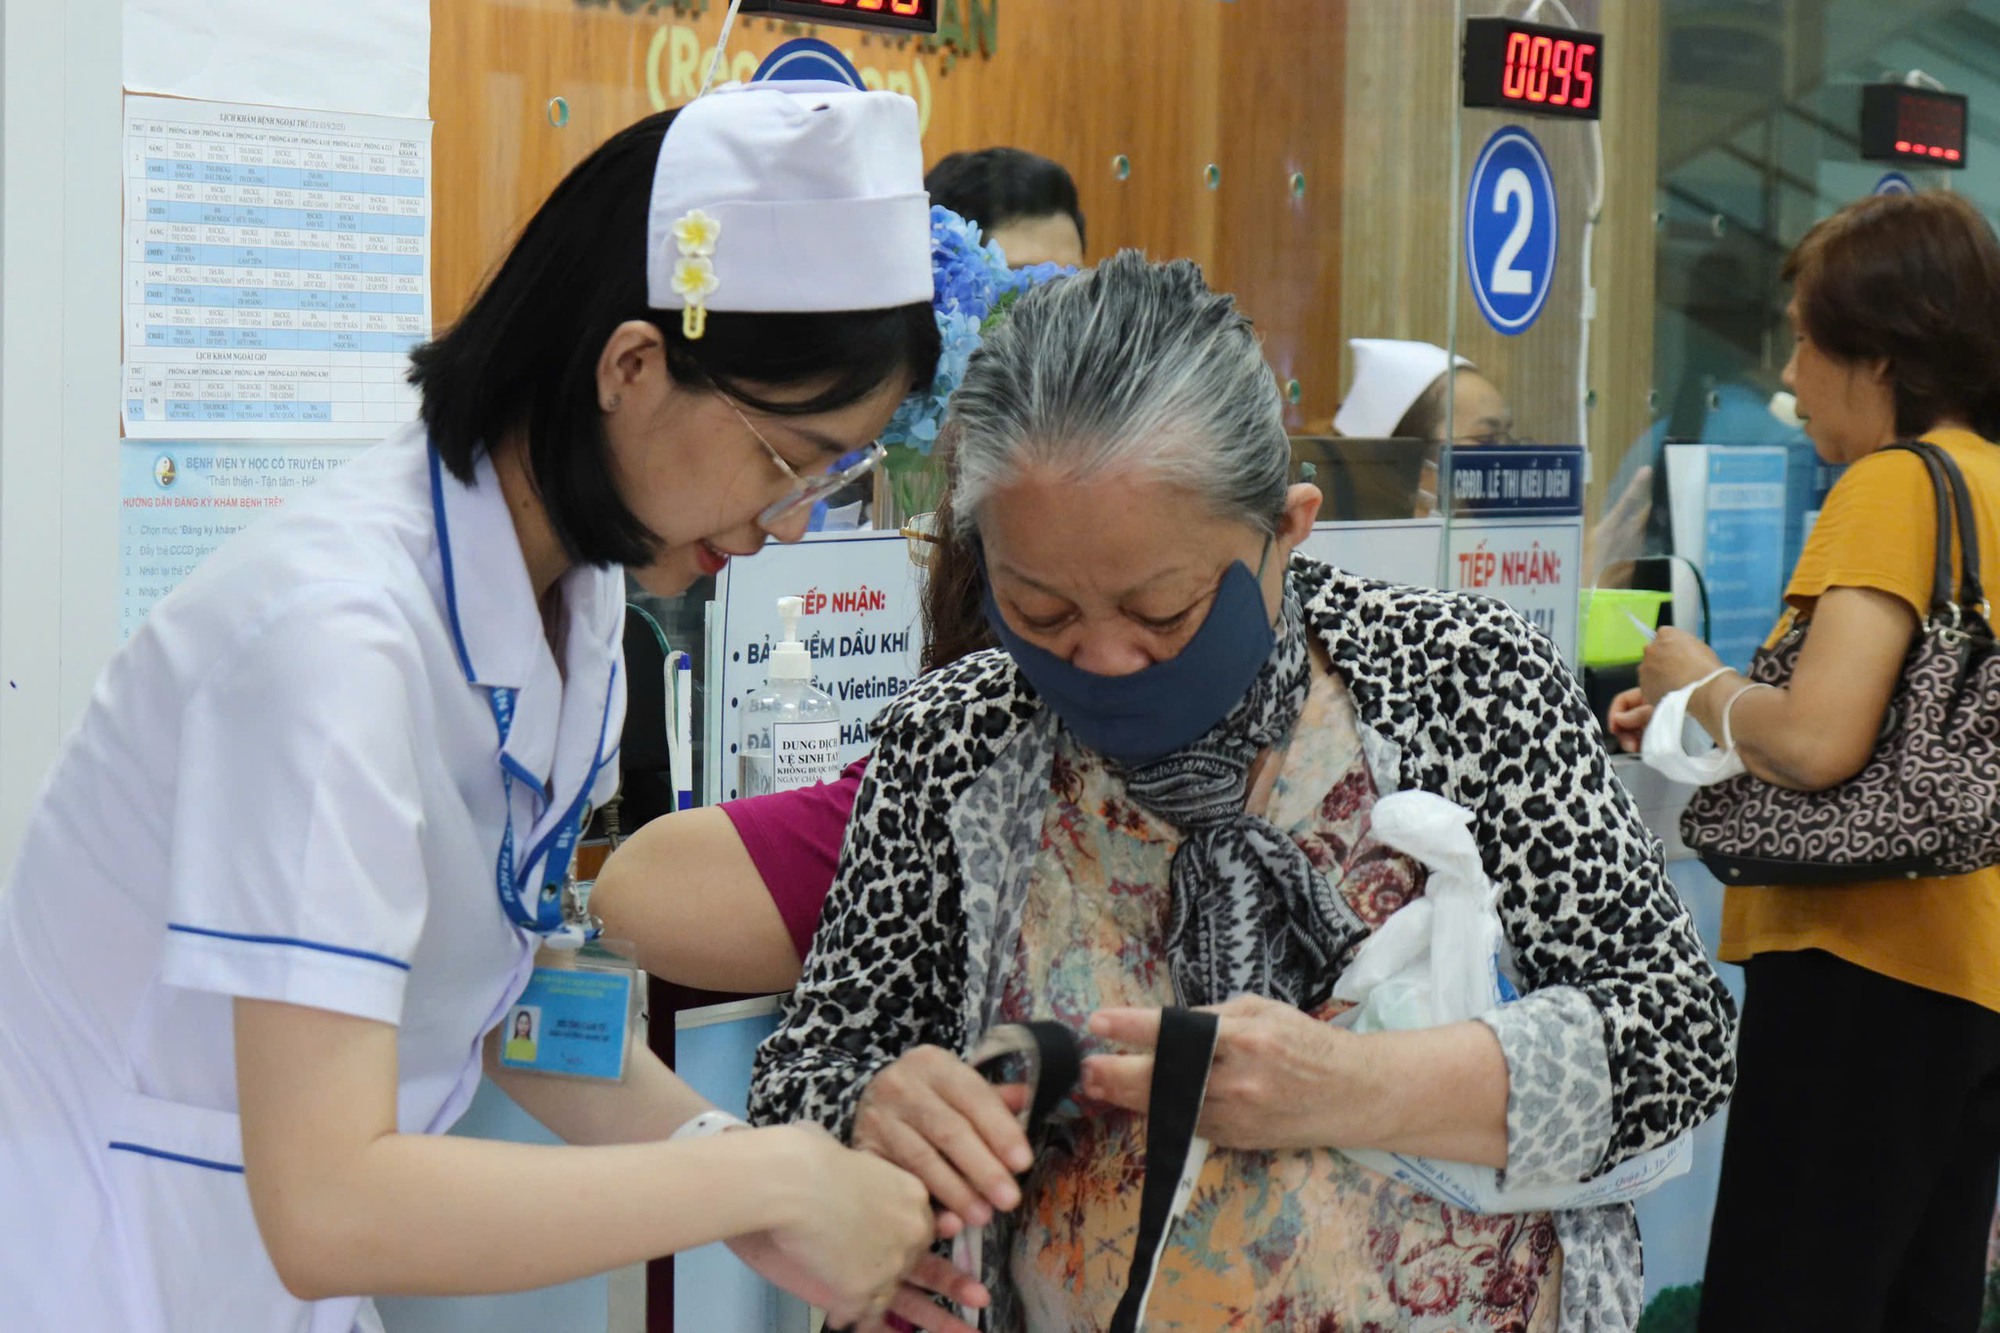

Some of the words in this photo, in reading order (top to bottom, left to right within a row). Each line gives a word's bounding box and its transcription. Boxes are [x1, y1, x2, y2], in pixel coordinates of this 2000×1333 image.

[1503, 31, 1595, 108] 0095
[1491, 168, 1533, 294] 2
[186, 456, 213, 472] BỆNH
[215, 456, 237, 472] VIỆN
[240, 458, 247, 469] Y
[248, 458, 268, 472] HỌC
[271, 456, 285, 470] CỔ
[287, 456, 324, 470] TRUYỀN
[261, 476, 277, 488] Tận
[279, 476, 294, 487] tâm
[1502, 468, 1520, 506] THỊ
[122, 496, 152, 508] HƯỚNG
[174, 496, 198, 508] ĐĂNG
[200, 496, 212, 508] KÝ
[214, 496, 238, 508] KHÁM
[240, 496, 262, 508] BỆNH
[1458, 538, 1496, 588] TIẾP
[1500, 540, 1561, 596] NHẬN:
[832, 584, 886, 617] NHẬN:
[840, 626, 876, 658] DẦU
[880, 626, 910, 654] KHÍ
[782, 740, 816, 751] DUNG
[819, 738, 838, 751] DỊCH
[798, 753, 824, 764] SINH
